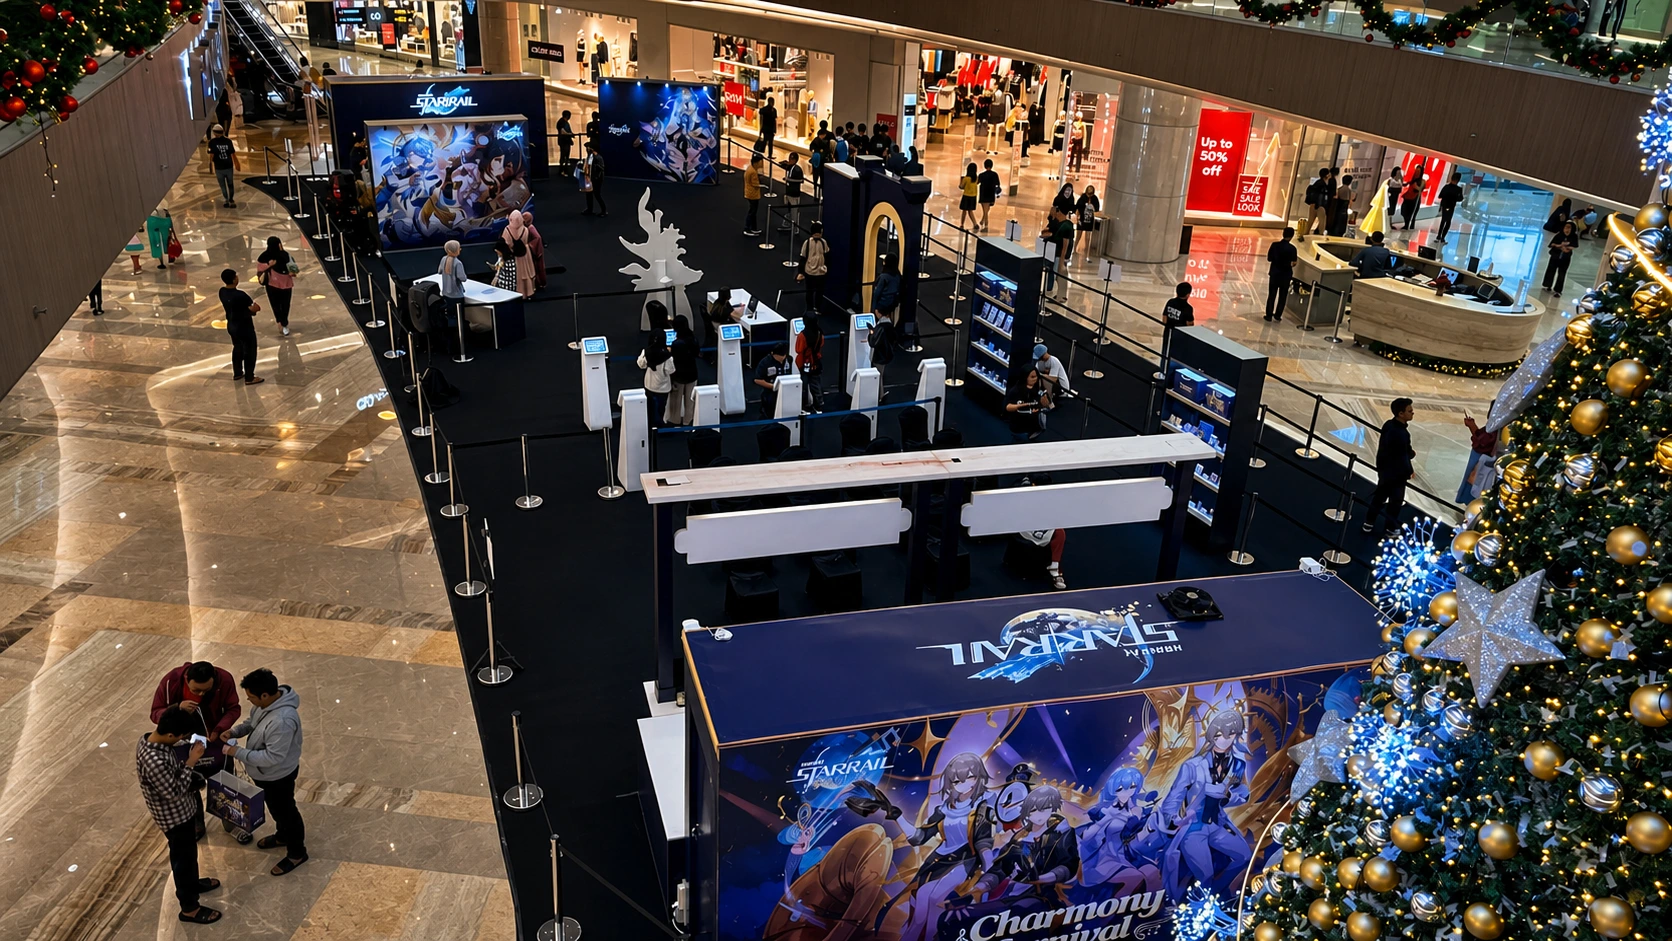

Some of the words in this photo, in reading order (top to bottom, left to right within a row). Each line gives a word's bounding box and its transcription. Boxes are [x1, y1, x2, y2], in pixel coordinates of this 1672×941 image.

[1201, 137, 1217, 150] Up
[1219, 138, 1233, 149] to
[1200, 151, 1228, 163] 50%
[1202, 165, 1222, 176] off
[970, 889, 1166, 941] Charmony
